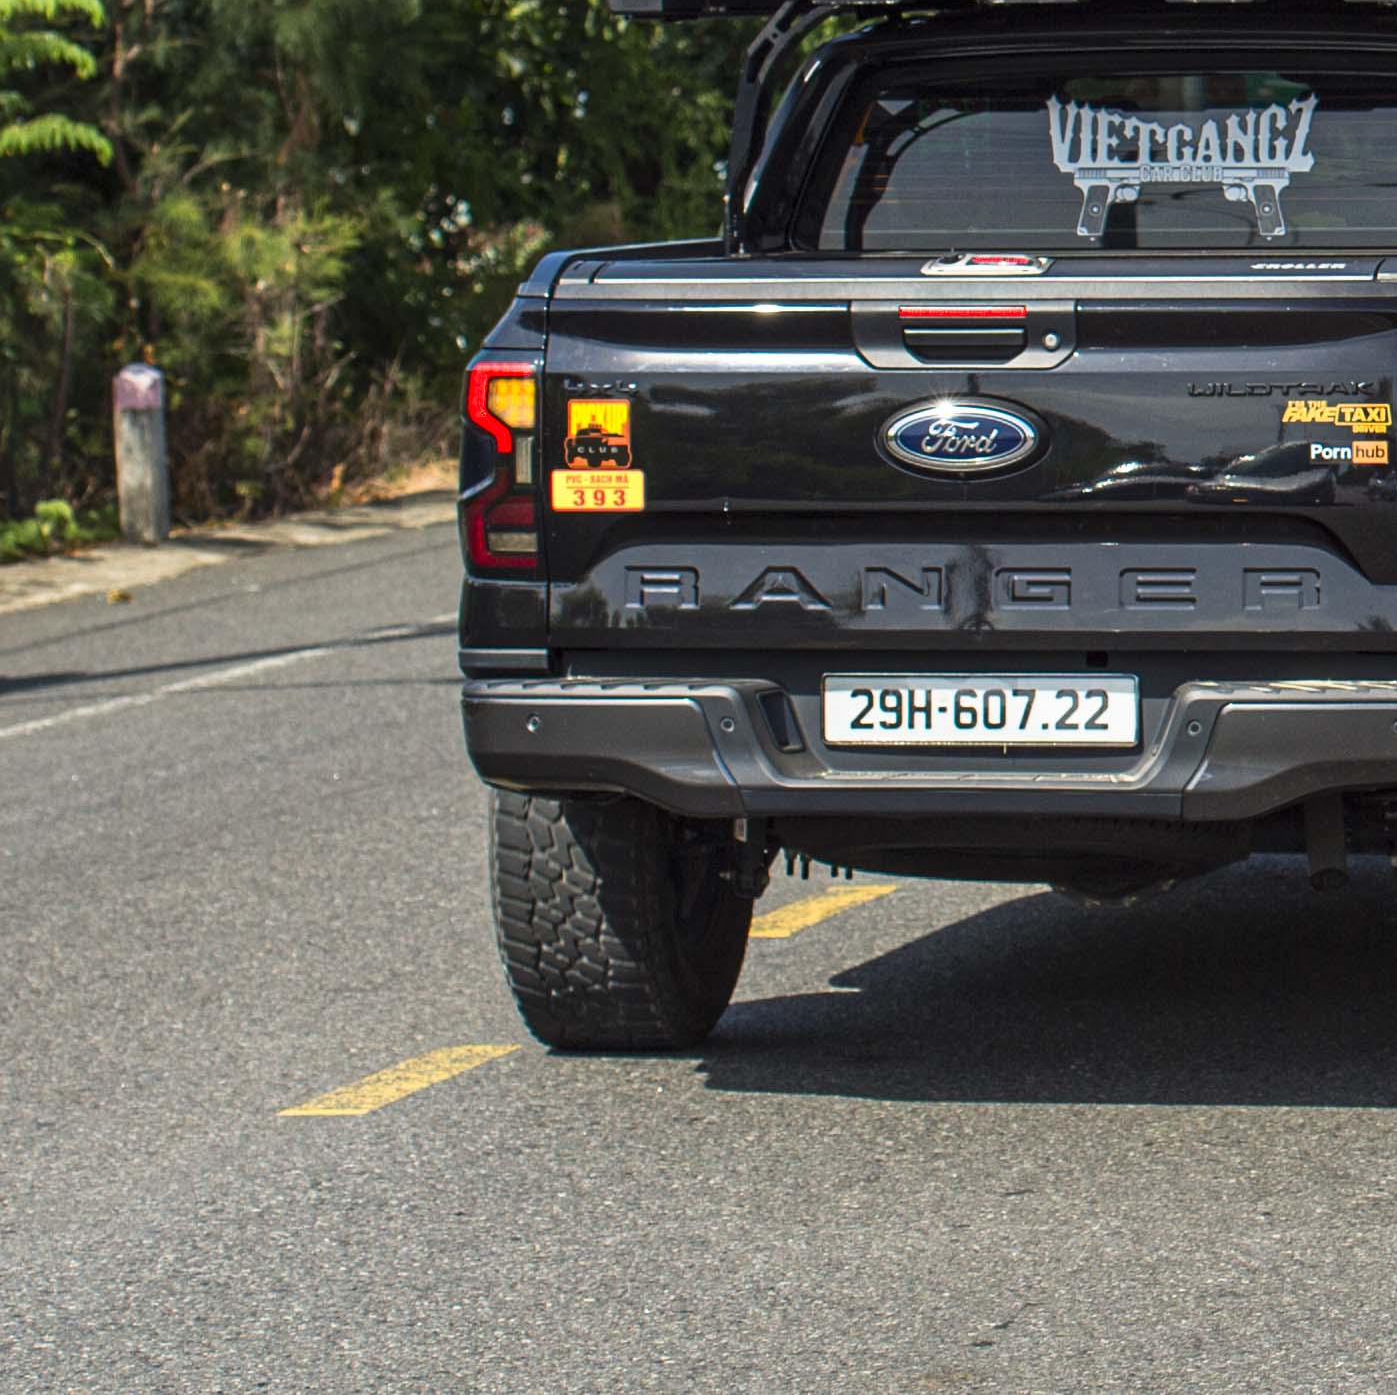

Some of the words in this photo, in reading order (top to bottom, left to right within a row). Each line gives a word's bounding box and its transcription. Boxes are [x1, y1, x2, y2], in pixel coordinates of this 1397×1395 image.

[1046, 93, 1319, 172] VIETGANGZ
[1140, 165, 1172, 182] CAR
[1180, 165, 1223, 182] CLUB
[1187, 381, 1375, 398] WILDTRAK
[1282, 406, 1336, 422] FAKE
[1340, 407, 1386, 422] TAXI
[922, 418, 999, 453] Ford
[577, 446, 619, 454] CLUB
[624, 565, 1323, 610] RANGER
[849, 688, 1110, 732] 29H-607.22
